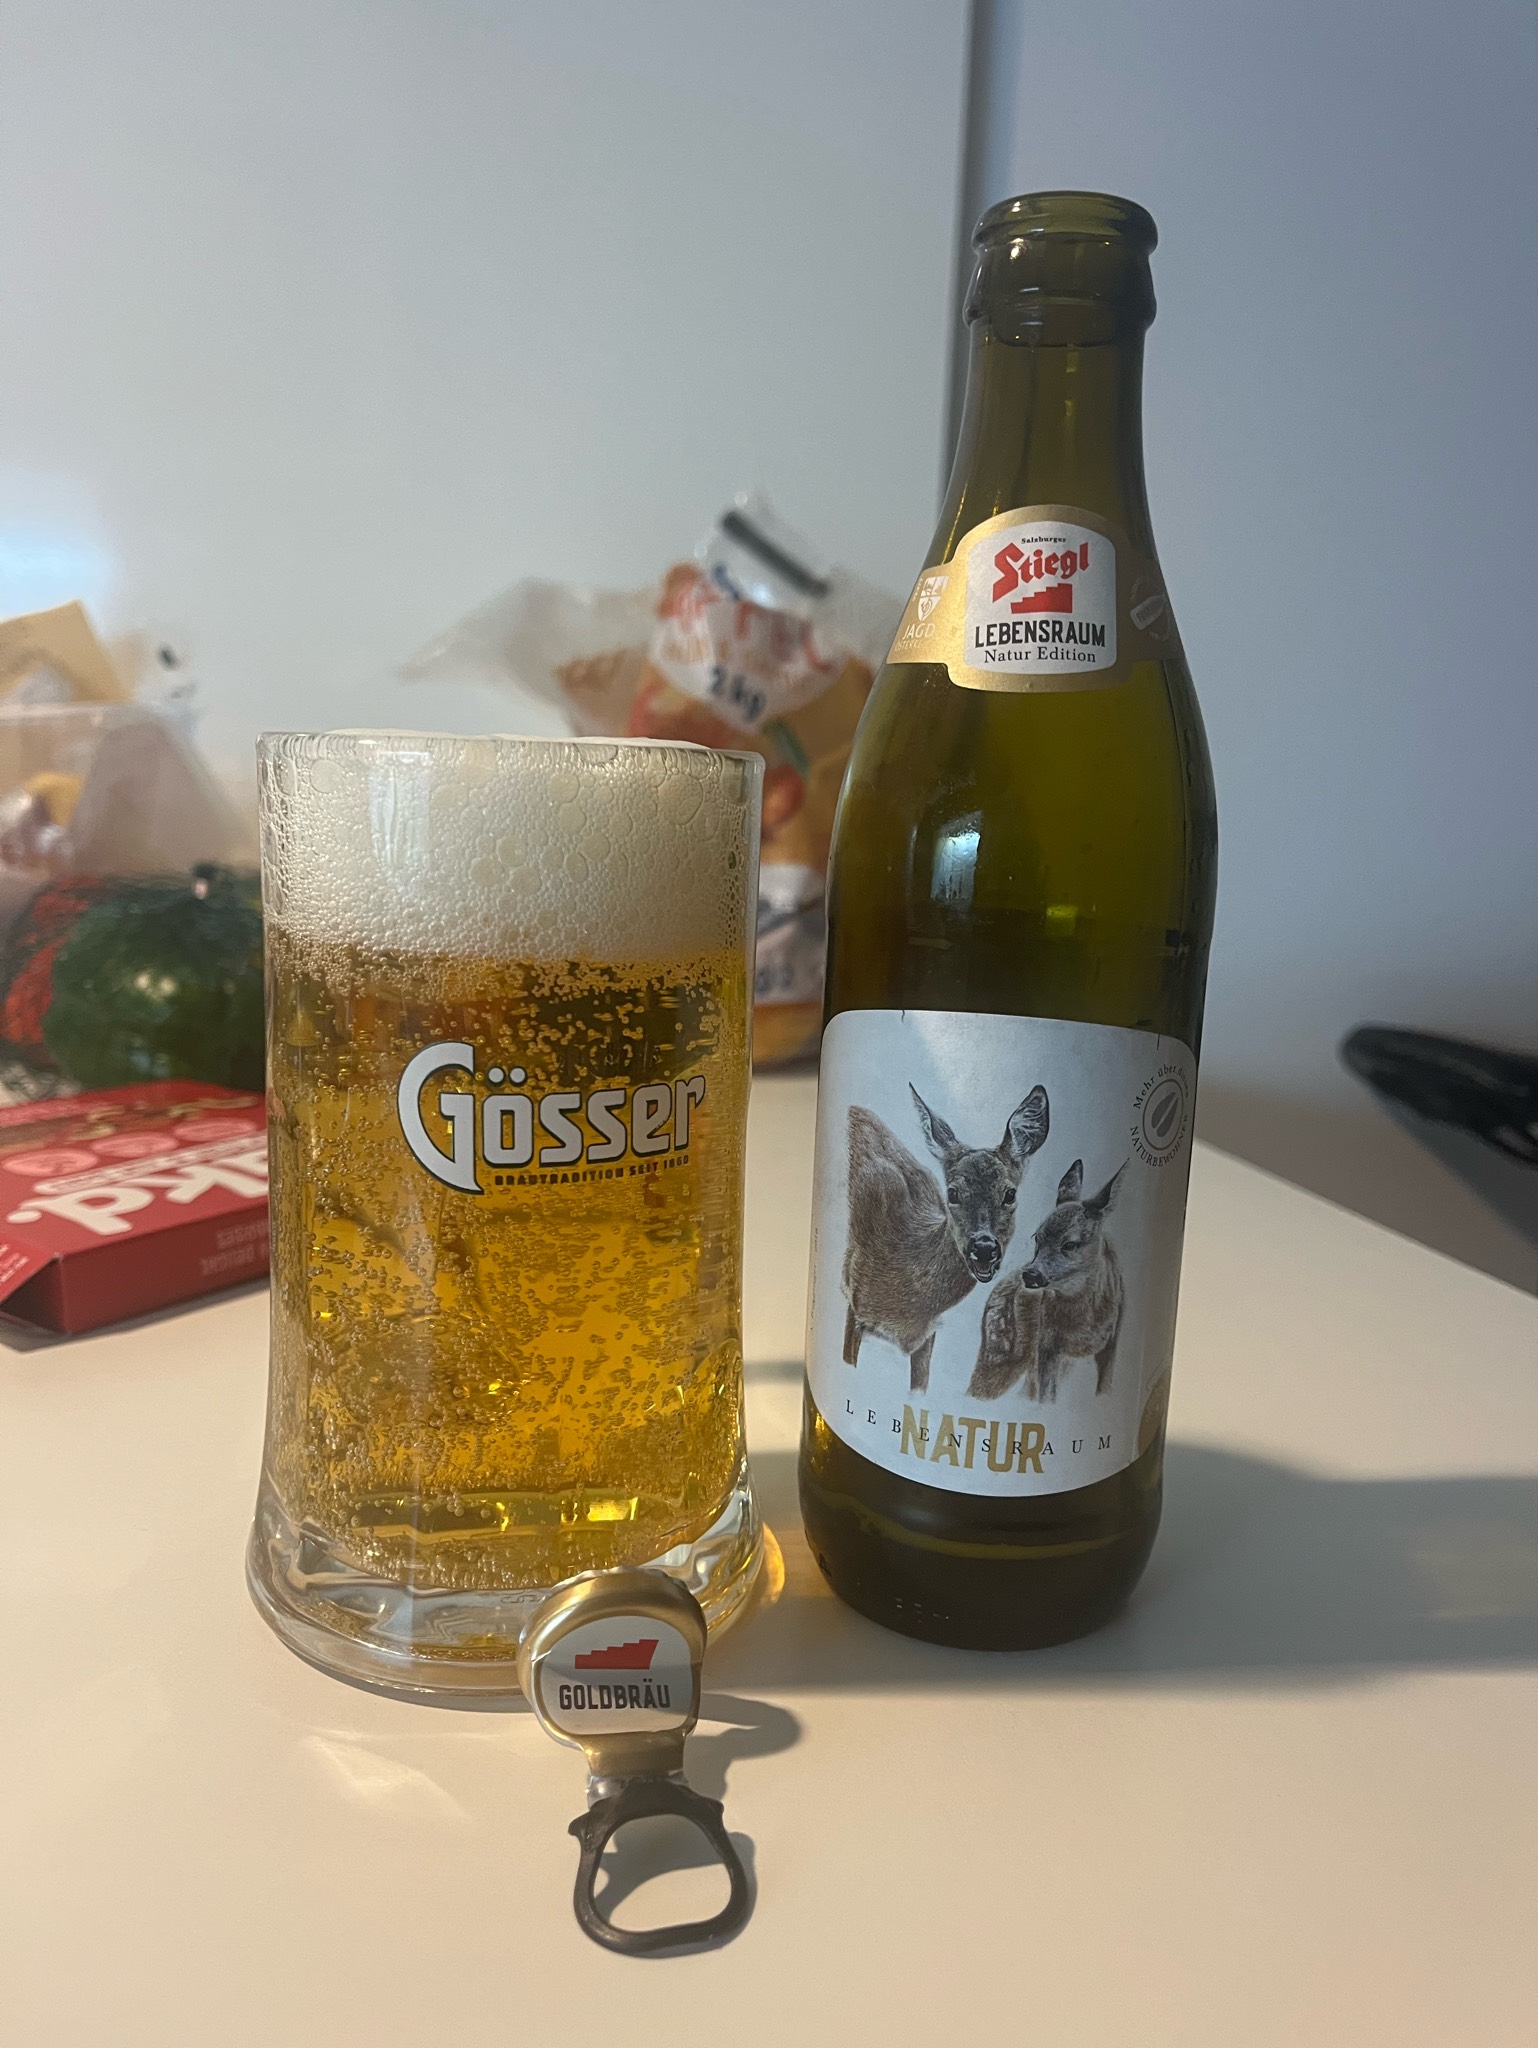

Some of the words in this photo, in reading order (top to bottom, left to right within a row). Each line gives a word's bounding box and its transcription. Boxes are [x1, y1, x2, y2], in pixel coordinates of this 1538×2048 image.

[1021, 536, 1067, 545] Salzburger
[992, 542, 1090, 604] Stiegl
[902, 623, 936, 640] JAGD
[974, 619, 1106, 649] LEBENSRAUM
[984, 647, 1032, 664] Natur
[1037, 646, 1096, 663] Edition
[1132, 1076, 1156, 1109] Mehr
[398, 1041, 706, 1195] Gösser
[495, 1166, 624, 1186] BRAUTRADITION
[629, 1160, 659, 1176] SEIT
[845, 1398, 1112, 1456] LEBENSRAUM
[900, 1403, 1047, 1474] NATUR
[558, 1678, 671, 1710] GOLDBRÄU
